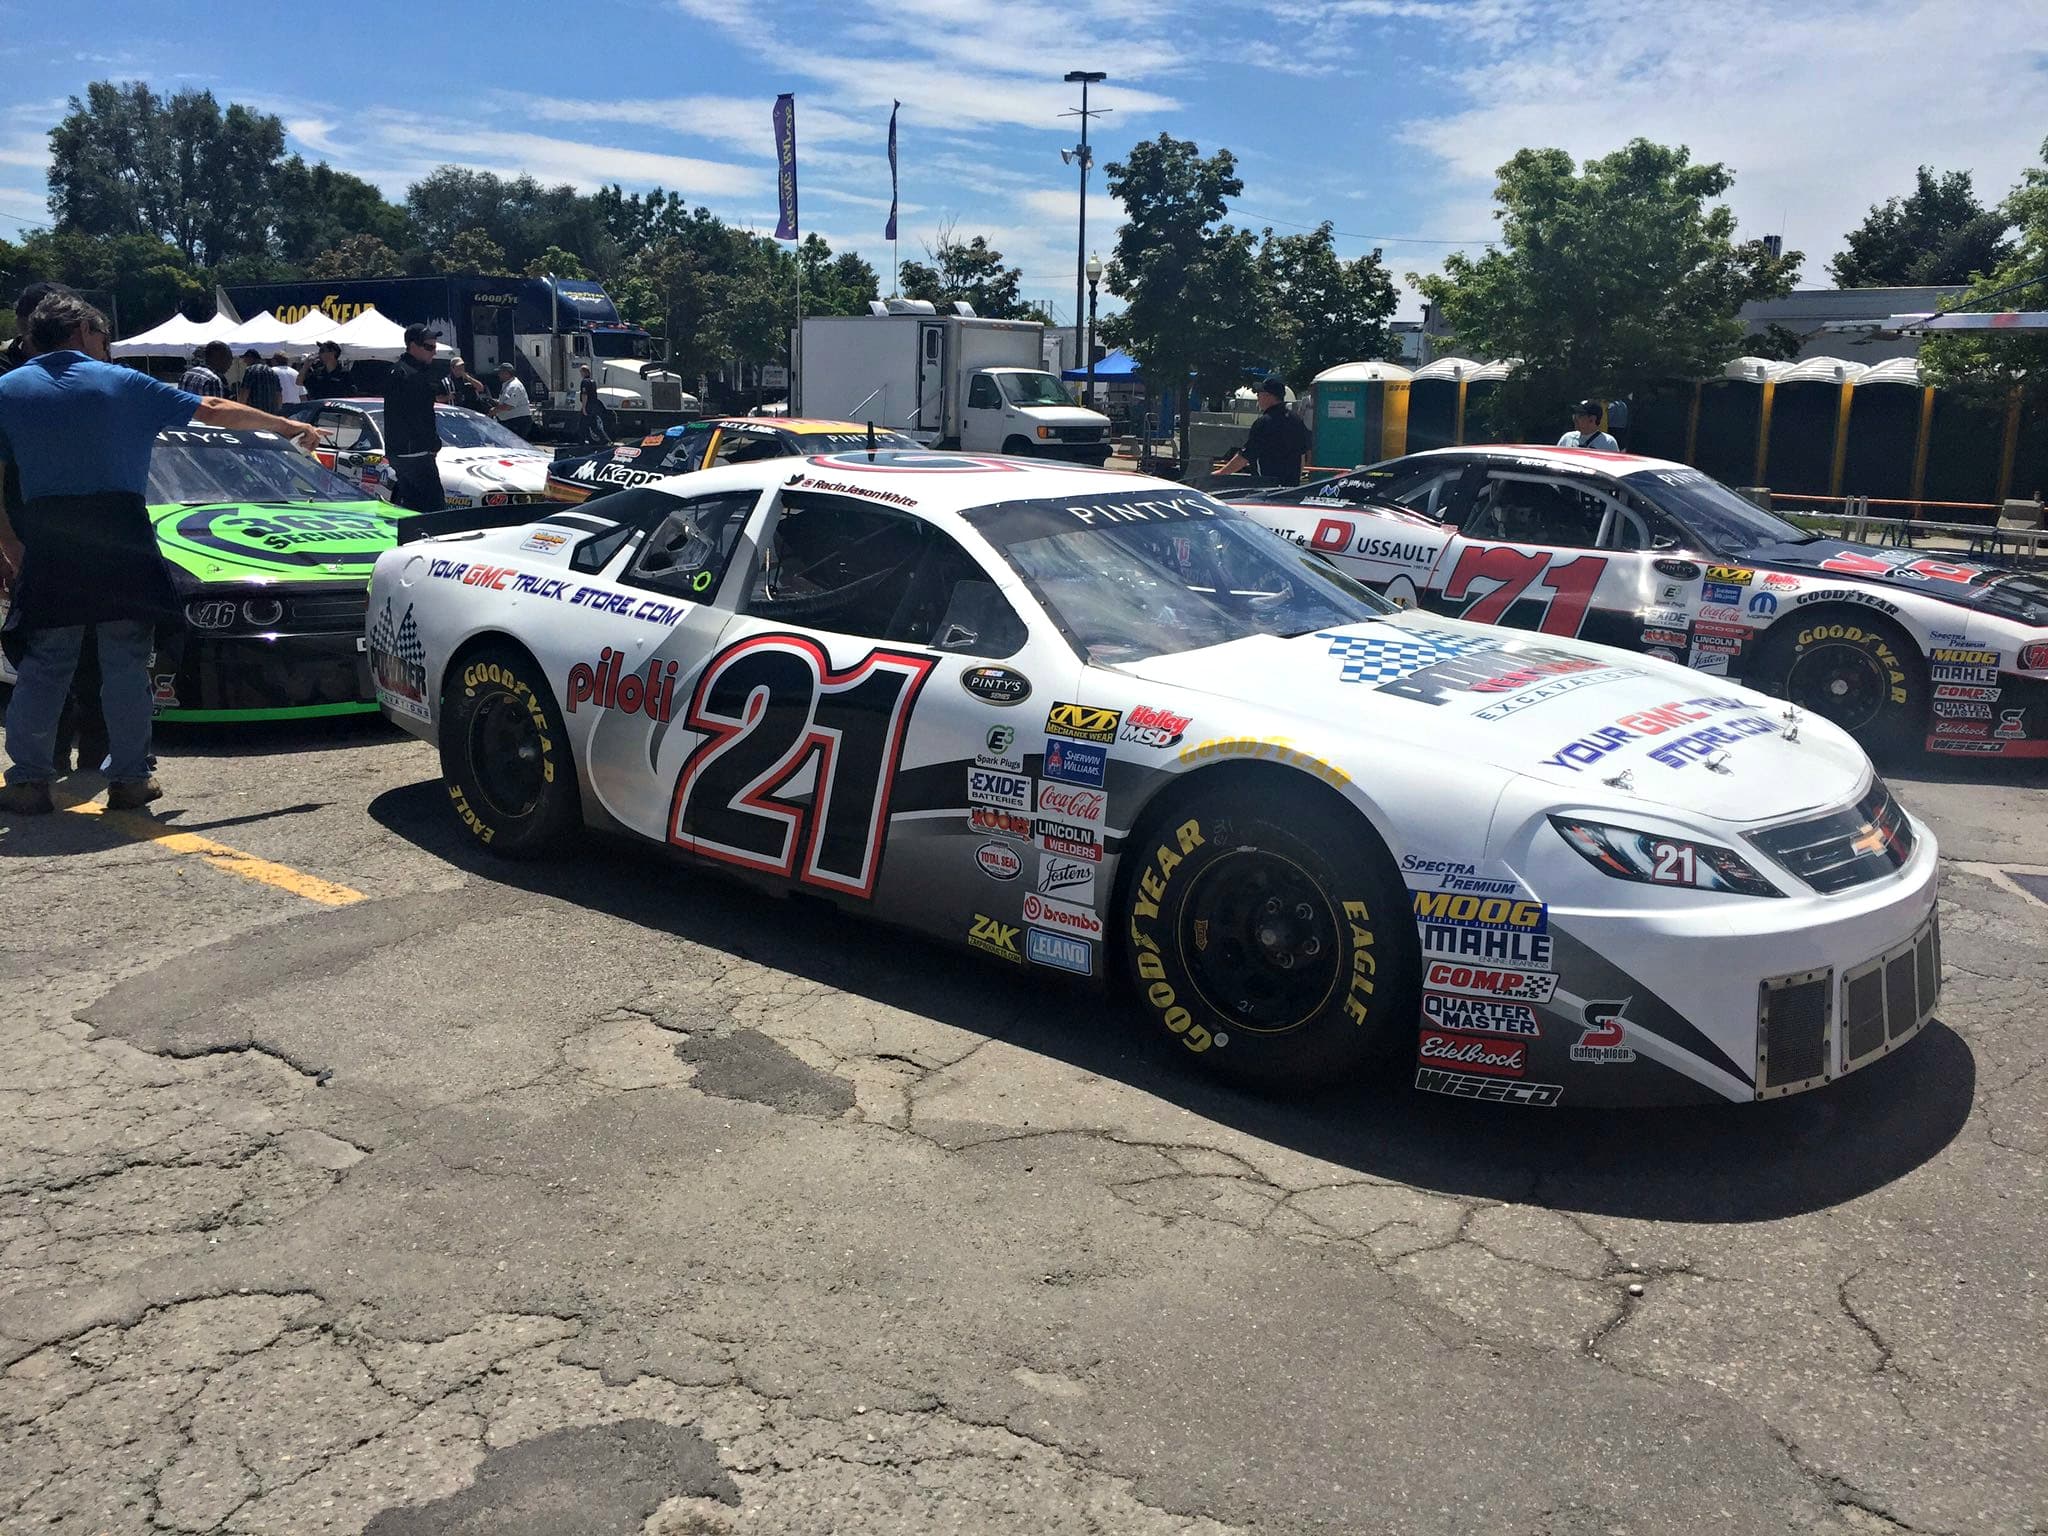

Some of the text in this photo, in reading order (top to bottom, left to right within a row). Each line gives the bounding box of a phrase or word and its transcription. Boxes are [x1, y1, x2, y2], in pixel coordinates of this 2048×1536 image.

[1065, 497, 1216, 526] PINTY'S
[223, 514, 377, 538] 365
[427, 558, 686, 628] YOUR GMC TRUCK STORE.COM
[1442, 545, 1608, 639] 71
[1797, 589, 1899, 616] GOODYEAR
[199, 602, 237, 629] 46
[1798, 624, 1908, 705] GOODYEAR
[1934, 649, 1998, 665] MOOG
[565, 645, 679, 724] piloti
[971, 677, 1022, 692] PINTY'S
[1933, 665, 1997, 682] MAHLE
[1937, 686, 1985, 699] COMP
[464, 662, 555, 784] GOODYEAR
[1126, 704, 1193, 736] Holley
[1120, 726, 1174, 746] MSD
[1538, 726, 1643, 773] YOUR
[1616, 701, 1713, 735] GMC
[666, 631, 943, 899] 21
[976, 753, 1021, 770] Spark Plugs
[1063, 760, 1101, 777] WILLIAMS
[1065, 750, 1101, 765] SHERWIN
[970, 772, 1027, 798] EXIDE
[972, 791, 1024, 807] BATTERIES
[449, 784, 496, 845] EAGLE
[1039, 821, 1092, 844] LINCOLN
[981, 851, 1017, 869] TOTAL SEAL
[1049, 839, 1097, 859] WELDERS
[1401, 853, 1475, 875] SPECTRA
[1652, 842, 1696, 885] 21
[1438, 873, 1517, 895] PREMIUM
[1044, 903, 1099, 933] brembo
[1413, 891, 1544, 928] MOOG
[968, 913, 1020, 952] ZAK
[1132, 818, 1213, 1052] GOODYEAR
[1424, 924, 1551, 963] MAHLE
[1342, 900, 1377, 1027] EAGLE
[1429, 965, 1524, 993] COMP
[1491, 988, 1541, 999] CAMS
[1424, 995, 1531, 1020] QUARTER
[1443, 1012, 1536, 1034] MASTER
[1420, 1037, 1523, 1069] Edelbrock
